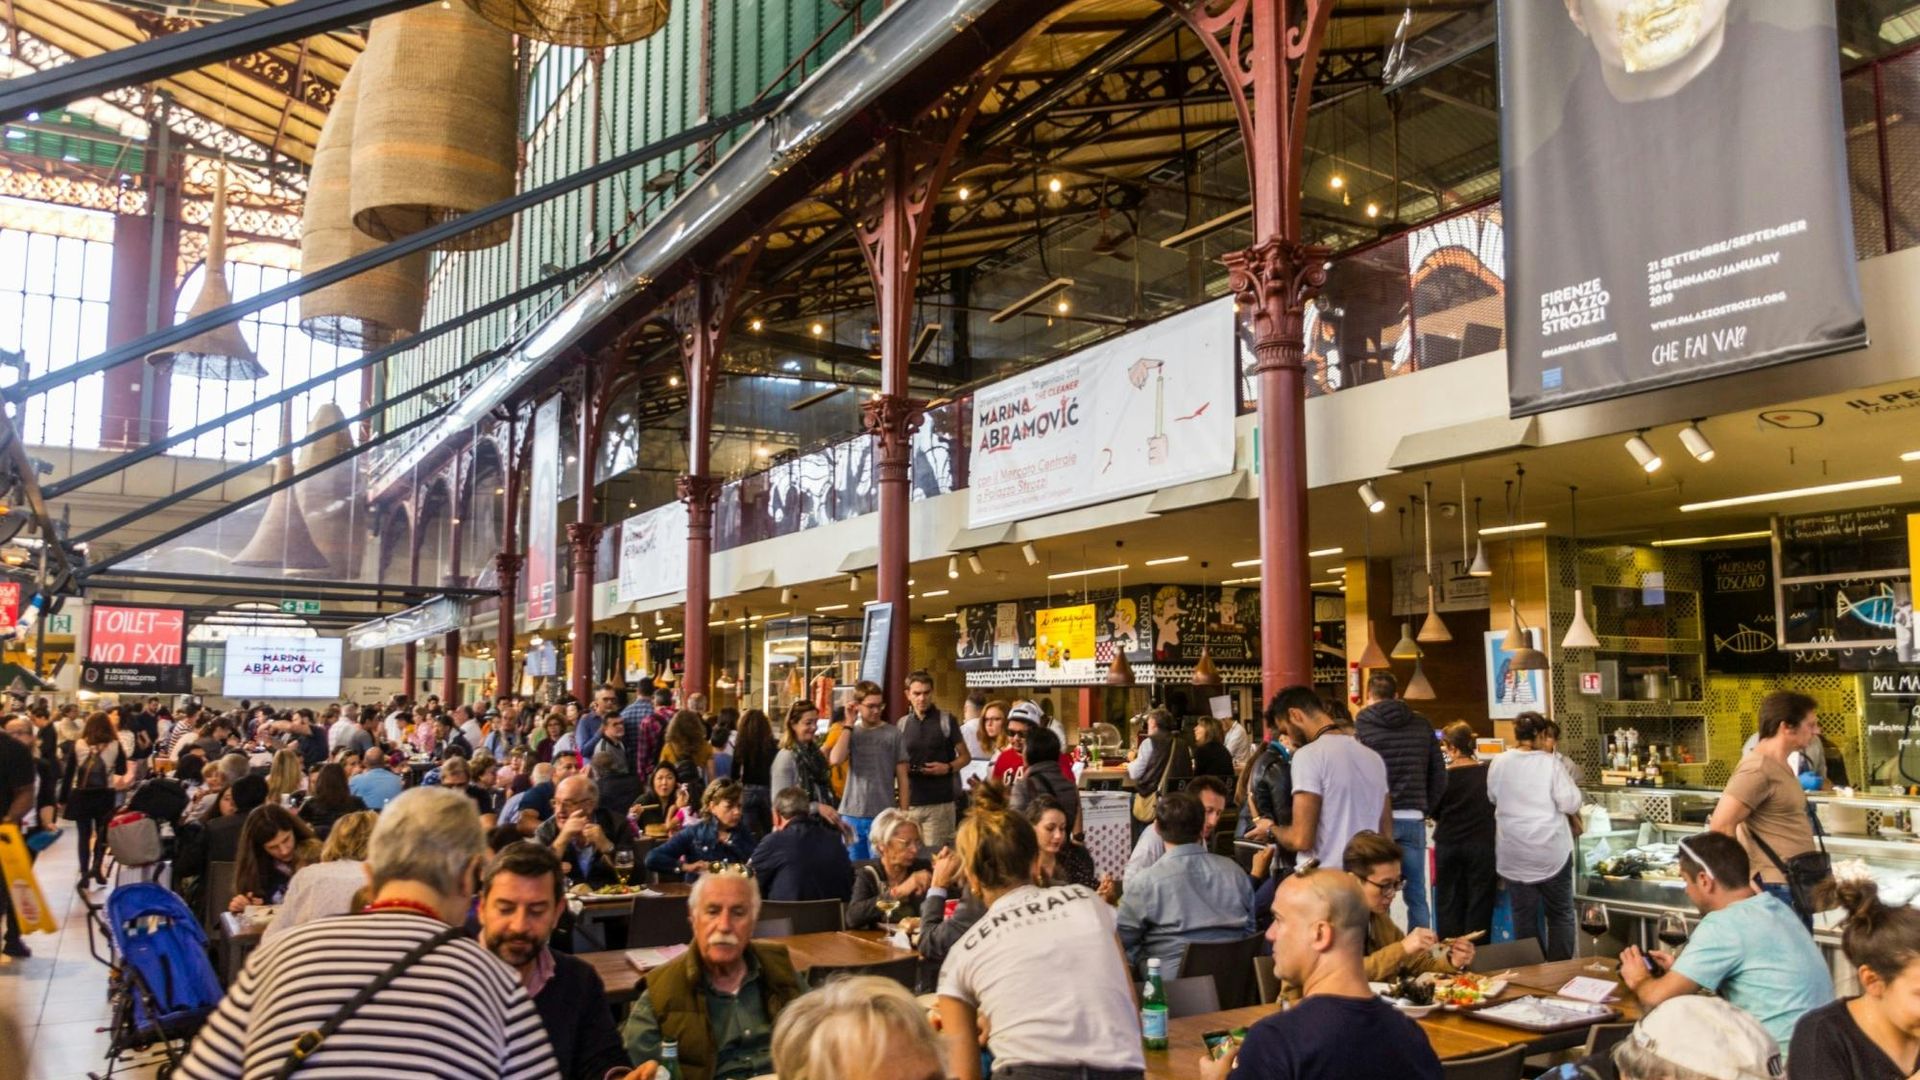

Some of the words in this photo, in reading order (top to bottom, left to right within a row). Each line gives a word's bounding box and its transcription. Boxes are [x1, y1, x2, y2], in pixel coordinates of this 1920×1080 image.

[1647, 260, 1660, 273] 21
[1661, 219, 1808, 269] SETTEMBRE/SEPTEMBER
[1648, 284, 1662, 296] 20
[1663, 251, 1781, 291] GENNAIO/JANUARY
[1648, 269, 1673, 284] 2018
[1541, 277, 1602, 307] FIRENZE
[1649, 292, 1674, 308] 2019
[1541, 291, 1610, 322] PALAZZO
[1651, 290, 1787, 331] WWW.PALAZZOSTROZZI.ORG
[1541, 306, 1606, 336] STROZZI
[1651, 340, 1680, 366] CHE
[1684, 332, 1708, 359] FAI
[1048, 380, 1080, 397] CLEANER
[1846, 399, 1880, 409] IL
[1879, 389, 1920, 403] PE
[979, 398, 1036, 428] MARINA
[1039, 453, 1078, 472] Centrale
[1716, 574, 1766, 590] TOSCANO
[95, 610, 161, 634] TOILET
[91, 643, 126, 663] NO
[132, 643, 180, 664] EXIT
[263, 654, 307, 663] MARINA
[1872, 675, 1895, 691] DAL
[964, 886, 1089, 951] CENTRALE
